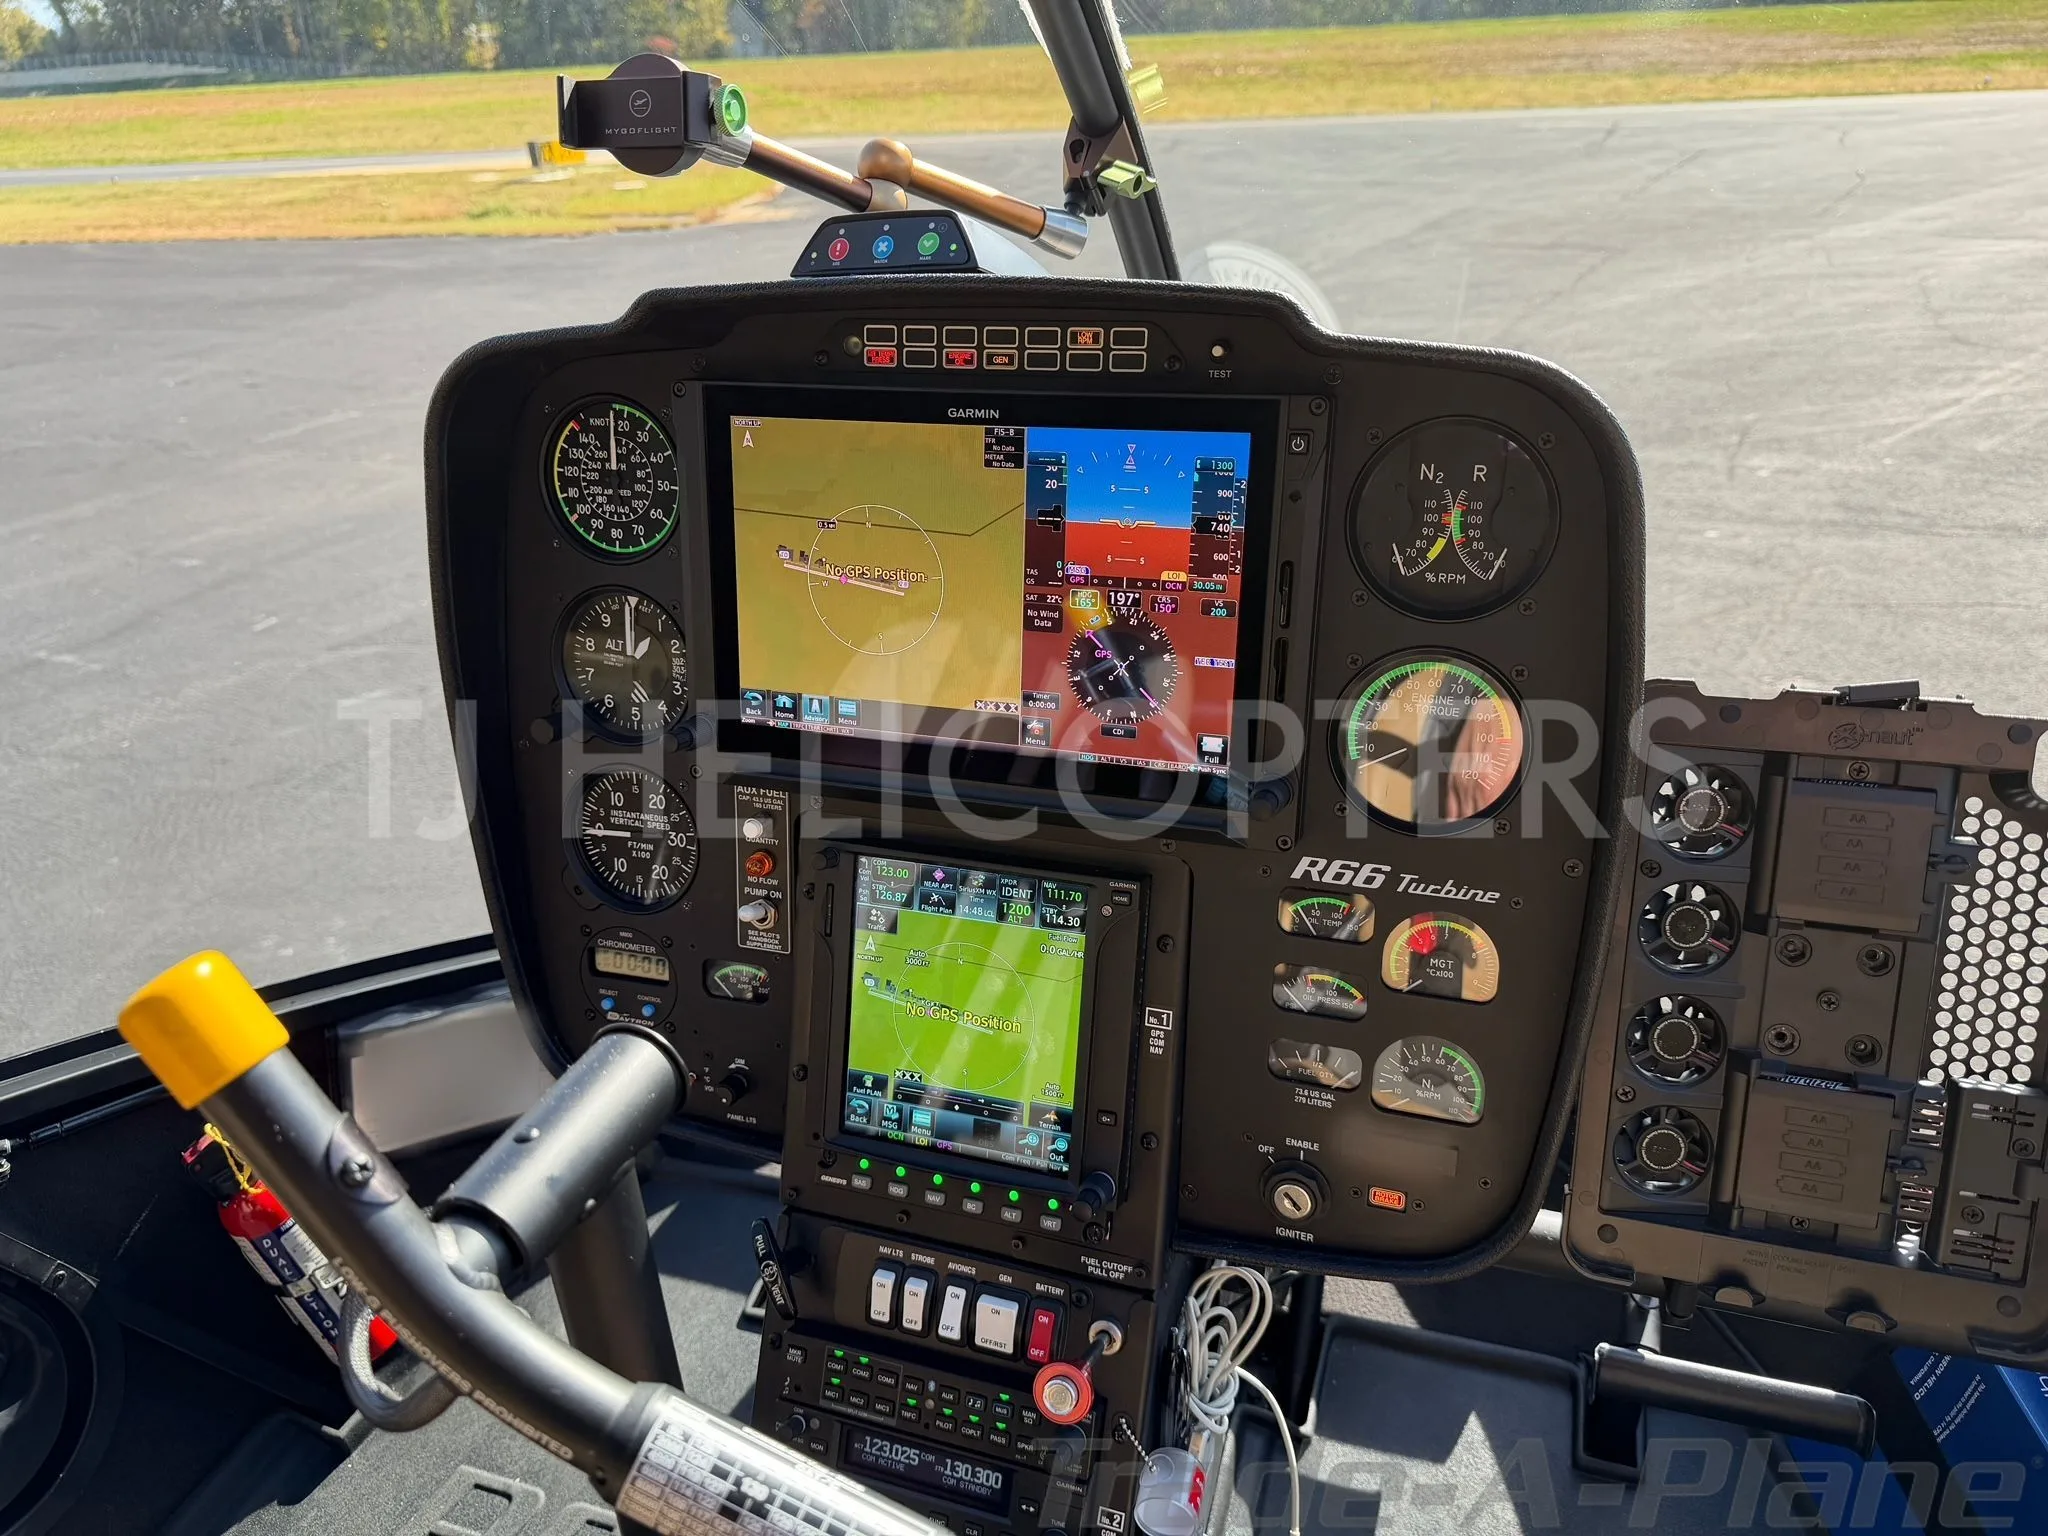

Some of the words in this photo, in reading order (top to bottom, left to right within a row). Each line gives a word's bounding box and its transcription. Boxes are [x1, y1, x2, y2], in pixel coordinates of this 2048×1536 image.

[605, 126, 678, 135] MYGOFLIGHT
[993, 356, 1009, 364] GEN
[1208, 370, 1232, 378] TEST
[948, 408, 1000, 419] GARMIN
[650, 453, 664, 464] 40
[1211, 461, 1233, 470] 1300
[564, 466, 580, 477] 120
[1473, 465, 1488, 483] R
[657, 481, 670, 491] 50
[1045, 479, 1058, 488] 20
[568, 487, 579, 498] 110
[1217, 489, 1233, 498] 900
[576, 503, 591, 515] 100
[1424, 500, 1437, 508] 110
[1470, 501, 1483, 510] 110
[650, 508, 663, 519] 60
[1423, 514, 1439, 522] 100
[1467, 515, 1483, 524] 100
[632, 525, 645, 536] 70
[1210, 522, 1230, 533] 740
[1421, 528, 1435, 536] 90
[611, 528, 623, 539] 80
[1468, 529, 1481, 538] 90
[1472, 542, 1484, 550] 80
[1213, 553, 1229, 561] 600
[825, 563, 842, 577] No
[845, 566, 872, 579] GPS
[874, 567, 926, 583] Position
[1424, 573, 1466, 584] %RPM
[1165, 582, 1182, 590] OCN
[1108, 592, 1140, 606] 197°
[1154, 603, 1176, 613] 150°
[1210, 608, 1227, 617] 200
[1027, 609, 1038, 618] No
[1039, 610, 1059, 619] Wind
[1034, 618, 1052, 627] Data
[605, 638, 624, 652] ALT
[1094, 650, 1112, 659] GPS
[1029, 701, 1056, 709] 0:00:00
[1411, 693, 1454, 706] ENGINE
[746, 707, 762, 716] Back
[774, 711, 794, 719] Home
[1403, 703, 1460, 717] %TORQUE
[804, 714, 828, 724] Advisory
[838, 718, 857, 726] Menu
[1025, 738, 1046, 746] Menu
[1476, 733, 1494, 743] 100
[1364, 744, 1375, 752] 10
[1204, 756, 1219, 764] Full
[1475, 753, 1490, 763] 110
[1461, 770, 1479, 780] 120
[736, 785, 758, 795] AUX
[760, 787, 786, 799] FUEL
[610, 809, 669, 822] INSTANTANEOUS
[610, 817, 644, 828] VERTICAL
[647, 821, 671, 831] SPEED
[627, 841, 654, 851] FT/MIN
[746, 837, 779, 846] QUANTITY
[876, 866, 909, 879] 123.00
[1109, 881, 1138, 890] GARMIN
[1290, 856, 1392, 889] R66
[1396, 873, 1501, 904] Turbine
[744, 887, 768, 897] PUMP
[769, 890, 783, 899] ON
[875, 890, 907, 903] 126.87
[958, 885, 985, 895] SiriusXM
[986, 888, 997, 897] WX
[1001, 888, 1033, 899] IDENT
[1047, 888, 1082, 902] 111.70
[959, 904, 983, 916] 14:48
[984, 910, 995, 918] LCL
[1002, 903, 1031, 916] 1200
[1008, 915, 1023, 924] ALT
[1045, 914, 1081, 927] 114.30
[748, 935, 780, 945] HANDBOOK
[597, 938, 657, 955] CHRONOMETER
[1040, 944, 1056, 954] 0.0
[1057, 949, 1085, 959] GAL/HR
[1430, 957, 1454, 969] MGT
[599, 988, 619, 997] SELECT
[637, 994, 663, 1004] CONTROL
[1302, 993, 1314, 1002] OIL
[1317, 996, 1341, 1006] PRESS
[606, 1011, 655, 1027] DAVTRON
[906, 1001, 925, 1018] No
[930, 1006, 959, 1023] GPS
[962, 1012, 1022, 1033] Position
[1150, 1029, 1165, 1039] GPS
[1149, 1046, 1164, 1056] NAV
[1415, 1089, 1441, 1100] %RPM
[1294, 1095, 1307, 1104] 279
[1307, 1098, 1332, 1108] LITERS
[850, 1114, 868, 1125] Back
[881, 1119, 898, 1129] MSG
[911, 1125, 932, 1137] Menu
[1039, 1121, 1061, 1132] Terrain
[888, 1131, 904, 1142] OCN
[936, 1140, 953, 1151] GPS
[1258, 1144, 1275, 1154] OFF
[1286, 1138, 1320, 1151] ENABLE
[1049, 1152, 1064, 1163] Out
[821, 1174, 847, 1186] GENESYS
[1375, 1191, 1399, 1201] ROTOR
[1004, 1210, 1017, 1219] ALT
[1275, 1227, 1314, 1243] IGNITER
[755, 1234, 767, 1258] PULL
[262, 1238, 293, 1276] DUAL
[911, 1252, 935, 1265] STROBE
[948, 1261, 976, 1275] AVIONICS
[1081, 1255, 1103, 1267] FUEL
[1104, 1258, 1133, 1274] CUTOFF
[1087, 1264, 1107, 1278] PULL
[1109, 1269, 1125, 1281] OFF
[876, 1281, 886, 1289] ON
[1035, 1283, 1064, 1297] BATTERY
[771, 1284, 785, 1305] VENT
[908, 1290, 919, 1298] ON
[303, 1294, 339, 1337] CTION
[873, 1309, 887, 1318] OFF
[904, 1317, 918, 1327] OFF
[980, 1337, 1007, 1350] OFF/RST
[827, 1361, 844, 1371] COM1
[1909, 1356, 1936, 1386] CALIFORNIA
[852, 1367, 870, 1378] COM2
[380, 1308, 473, 1393] PUSHOVERS
[472, 1390, 574, 1461] PROHIBITED
[1914, 1374, 1937, 1401] HELICO
[941, 1391, 954, 1400] AUX
[935, 1419, 953, 1431] PILOT
[961, 1425, 982, 1437] COPLT
[990, 1433, 1006, 1444] PASS
[863, 1436, 919, 1466] 123.025
[921, 1453, 936, 1463] COM
[861, 1454, 876, 1463] COM
[878, 1457, 906, 1472] ACTIVE
[944, 1458, 1003, 1488] 130.300
[942, 1476, 957, 1486] COM
[959, 1480, 993, 1496] STANDBY
[1056, 1480, 1083, 1493] GARMIN
[1051, 1519, 1066, 1528] TUNE
